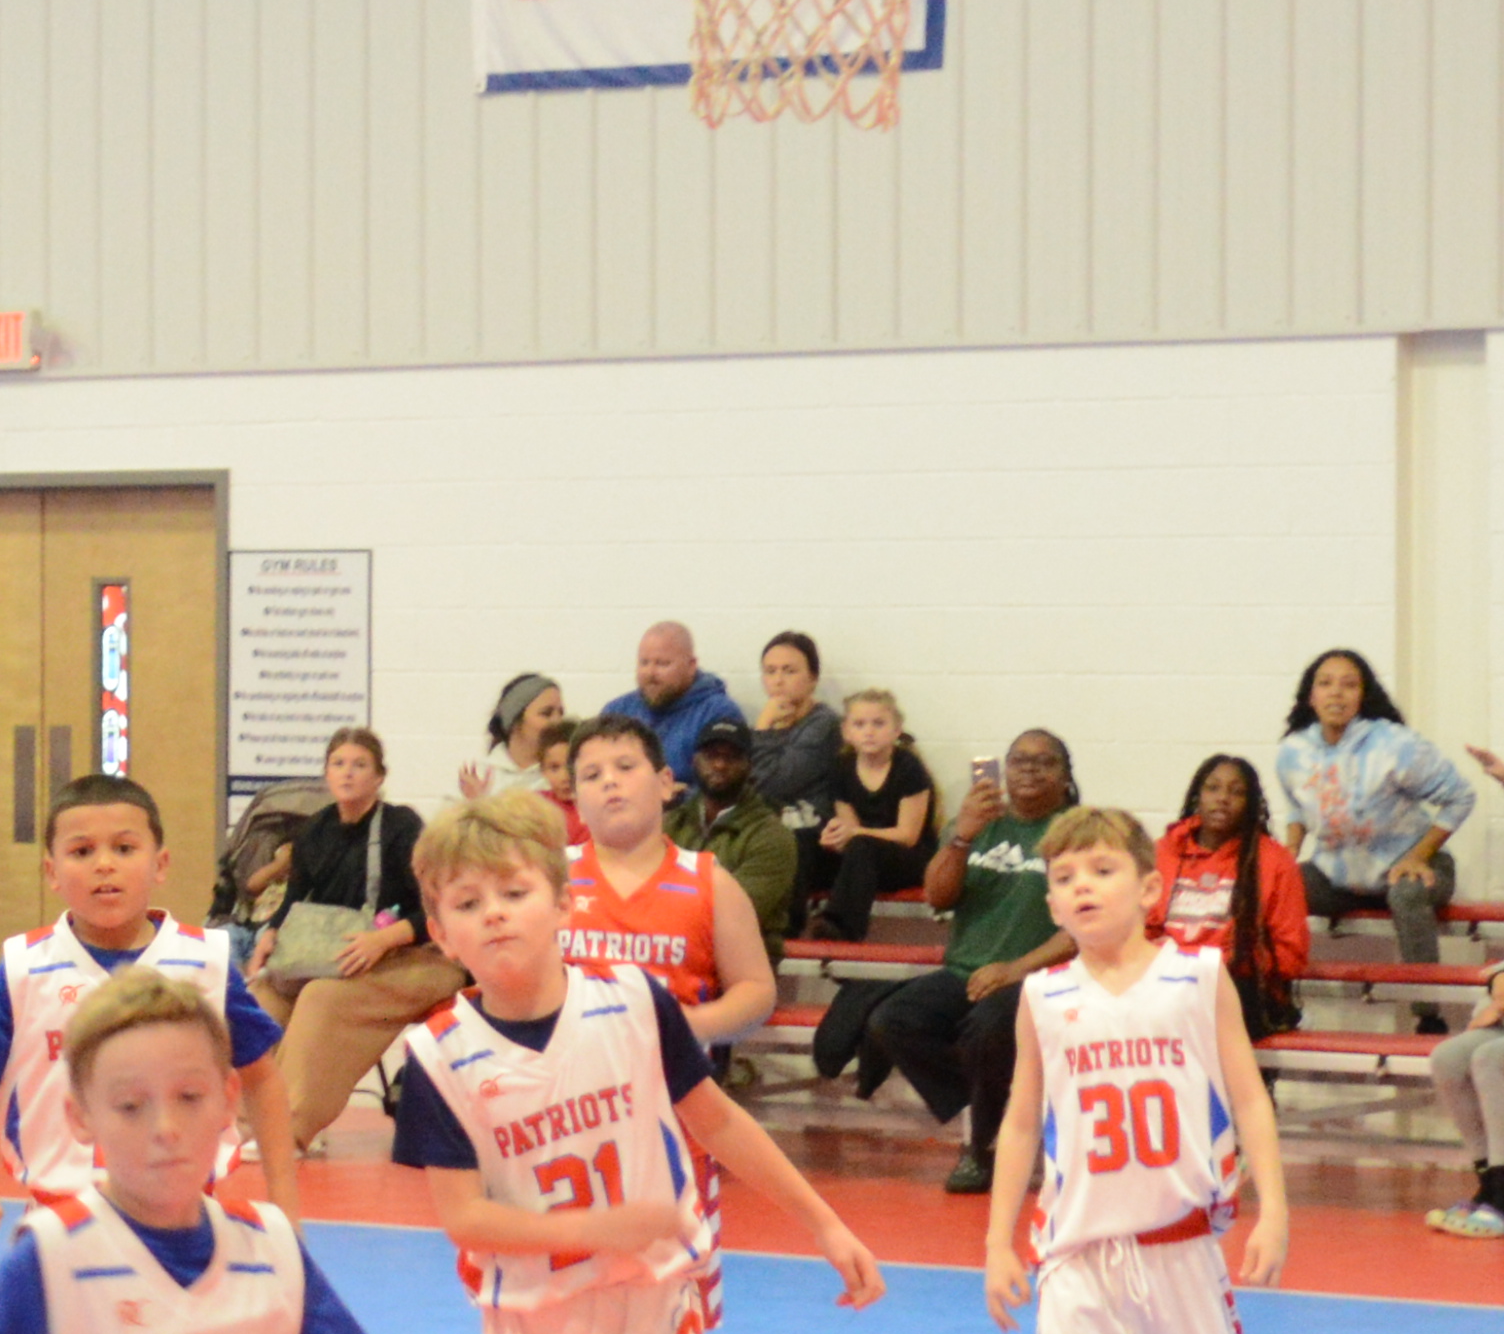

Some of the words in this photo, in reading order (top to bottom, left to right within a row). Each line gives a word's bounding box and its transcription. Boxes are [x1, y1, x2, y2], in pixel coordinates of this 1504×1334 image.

[557, 929, 687, 965] PATRIOTS
[1065, 1037, 1185, 1077] PATRIOTS
[1078, 1078, 1180, 1174] 30
